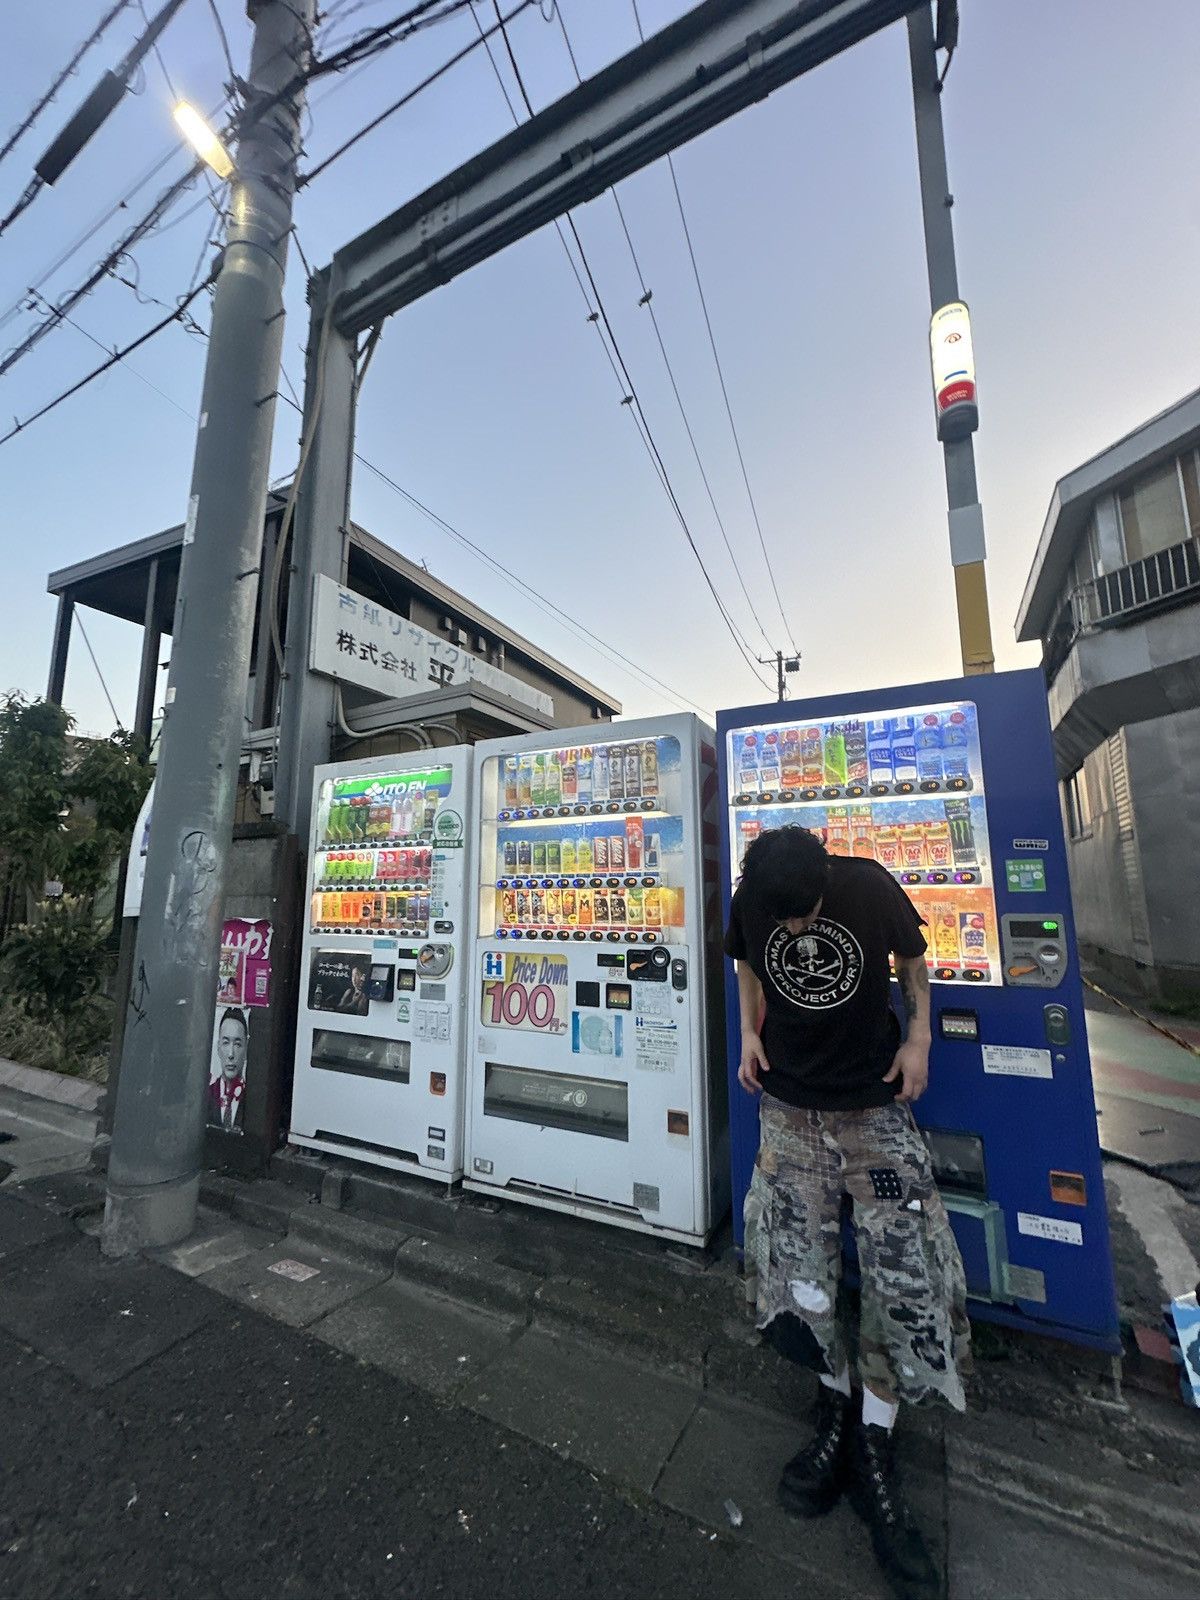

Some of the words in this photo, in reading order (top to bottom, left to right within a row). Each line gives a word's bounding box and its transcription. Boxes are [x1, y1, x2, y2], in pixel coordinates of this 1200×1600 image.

[336, 629, 418, 682] 株式会社
[770, 922, 854, 960] MASRMIND
[511, 956, 537, 983] Price
[775, 974, 839, 1003] PROJECT
[839, 967, 858, 992] G/R
